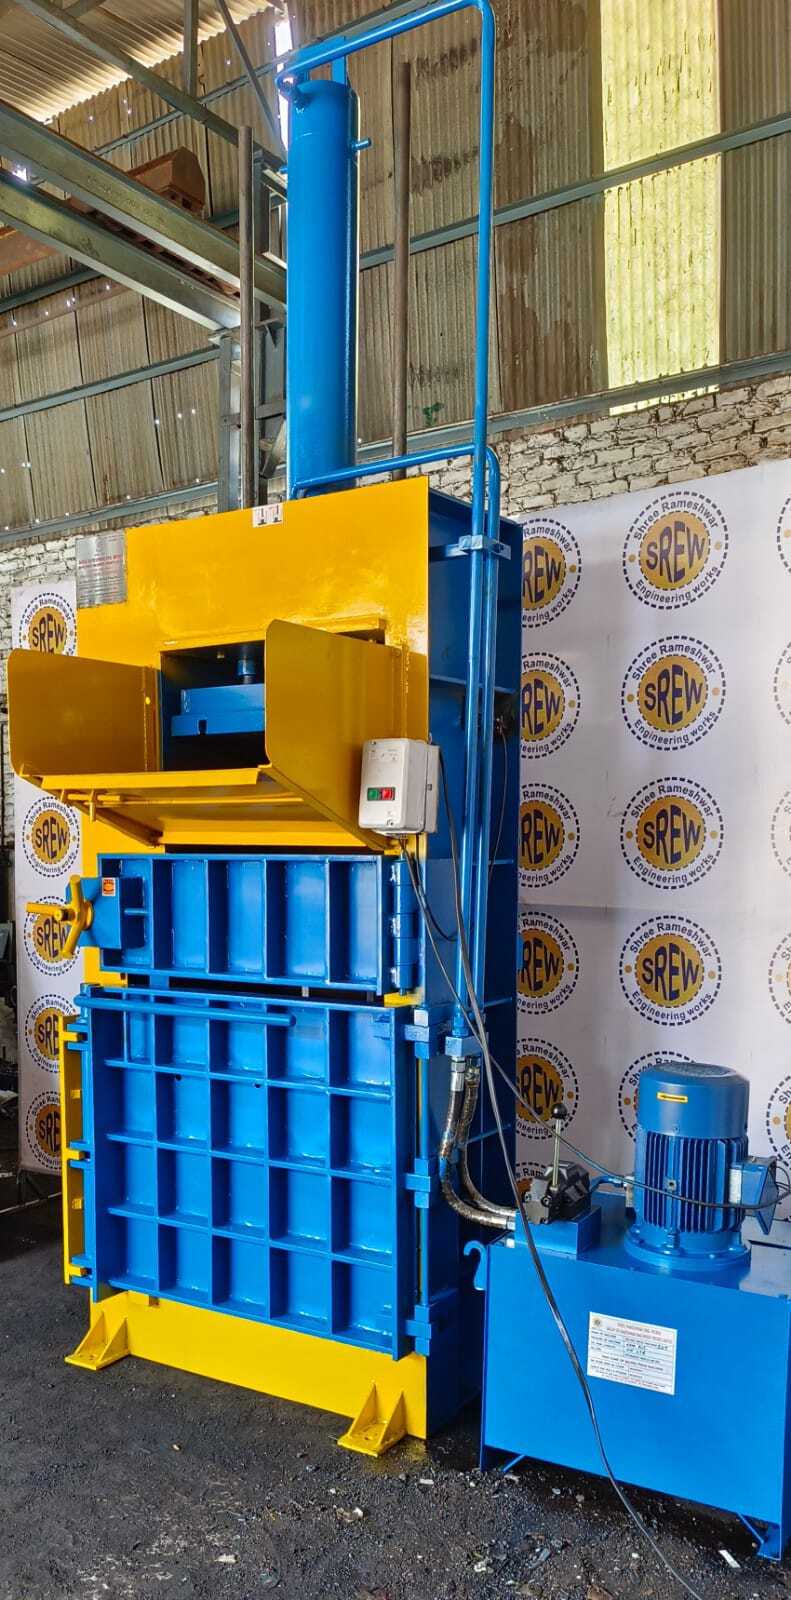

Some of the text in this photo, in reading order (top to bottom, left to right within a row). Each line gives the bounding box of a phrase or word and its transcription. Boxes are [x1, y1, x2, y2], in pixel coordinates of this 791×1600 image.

[634, 500, 718, 540] Shree Rameshwar
[524, 526, 572, 553] Rameshwar
[646, 521, 705, 583] SREW
[523, 545, 561, 603] REW
[636, 566, 718, 603] Engineering works
[551, 588, 572, 613] works
[32, 613, 64, 654] SREW
[523, 660, 571, 688] Rameshwar
[632, 644, 715, 680] Shree Rameshwar
[522, 678, 560, 736] REW
[644, 664, 703, 725] SREW
[550, 723, 572, 745] works
[635, 711, 715, 744] Engineering works
[523, 790, 571, 820] Rameshwar
[631, 785, 713, 818] Shree Rameshwar
[521, 809, 560, 864] REW
[643, 804, 701, 864] SREW
[549, 854, 571, 876] works
[633, 854, 713, 883] Engineering works
[522, 919, 570, 951] Rameshwar
[630, 922, 712, 957] Shree Rameshwar
[521, 938, 559, 991] REW
[642, 943, 699, 1001] SREW
[549, 984, 571, 1005] works
[632, 991, 711, 1020] Engineering works
[39, 1014, 59, 1055] SRE
[522, 1044, 569, 1079] Rameshwar
[518, 1063, 559, 1115] REW
[39, 1111, 60, 1152] SRE
